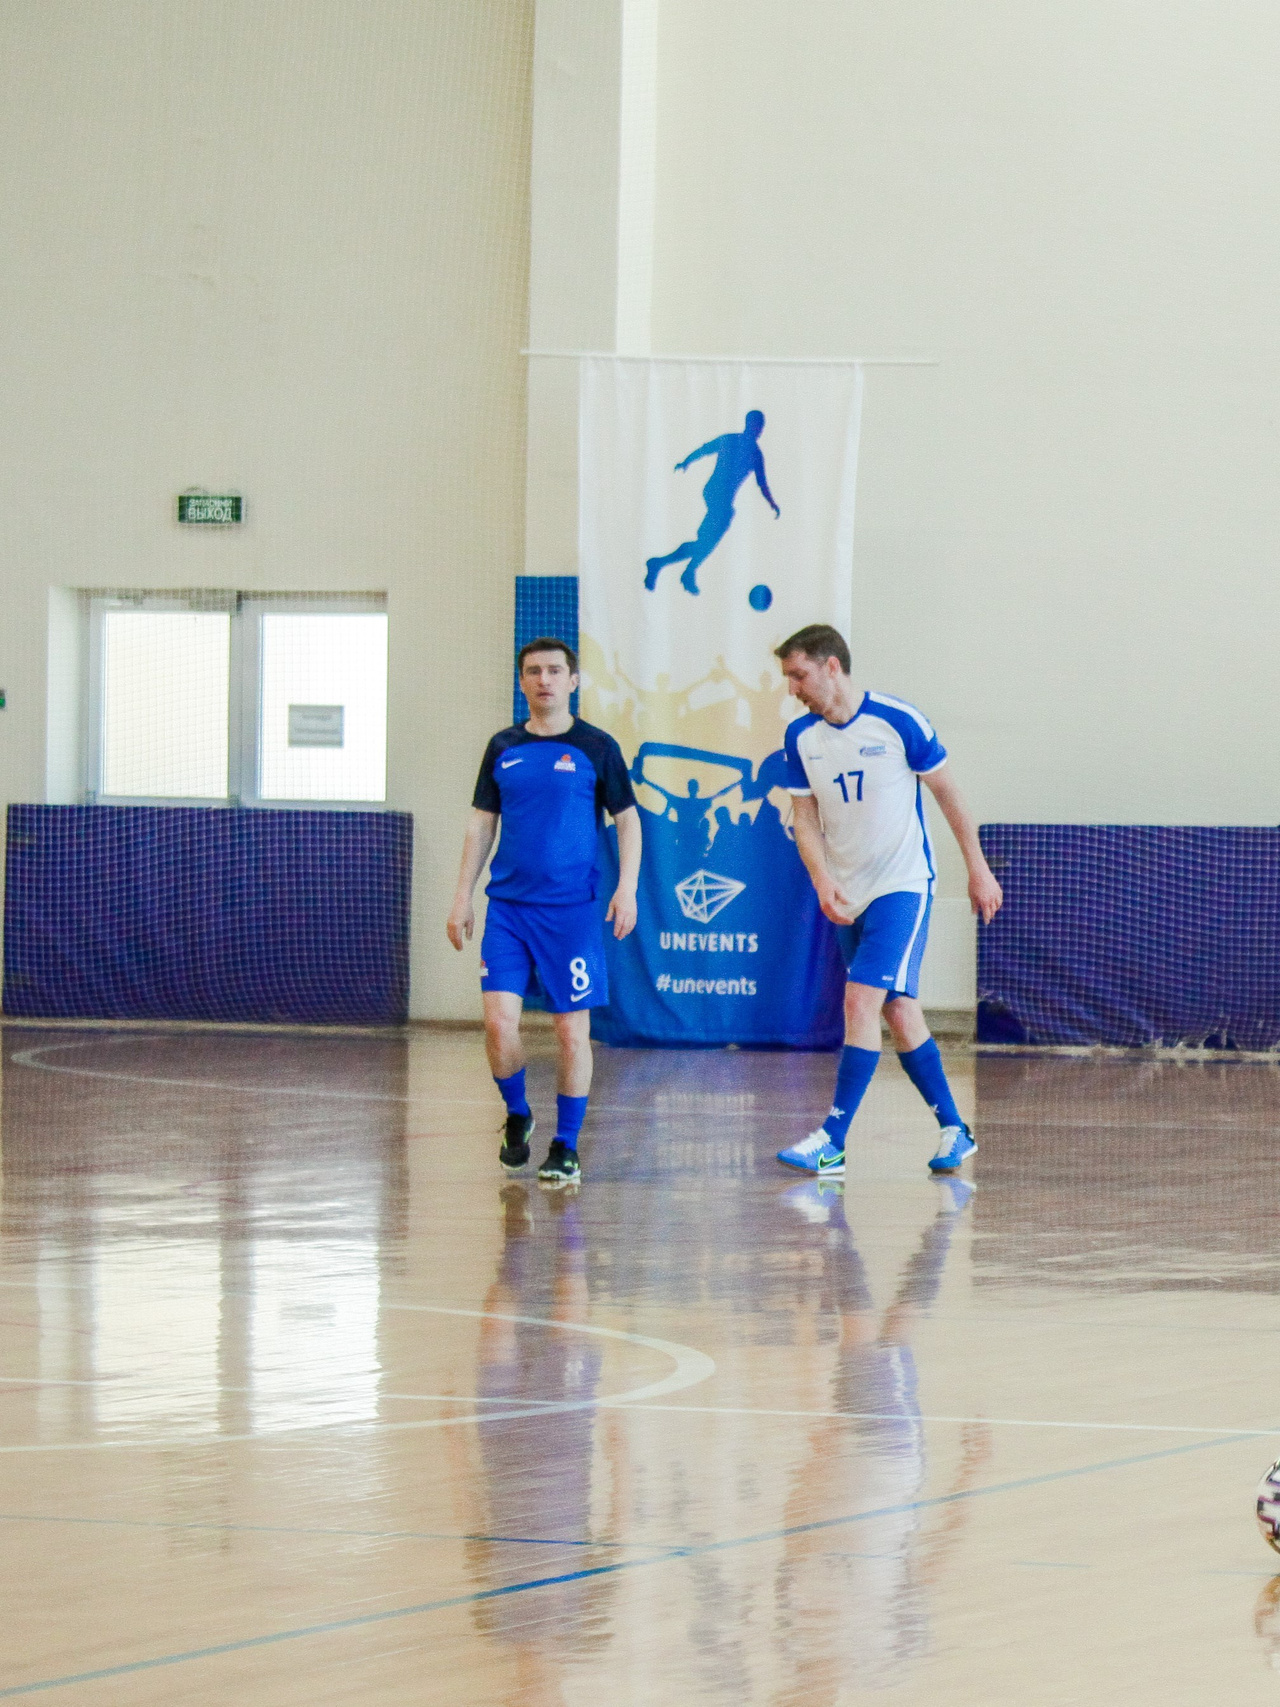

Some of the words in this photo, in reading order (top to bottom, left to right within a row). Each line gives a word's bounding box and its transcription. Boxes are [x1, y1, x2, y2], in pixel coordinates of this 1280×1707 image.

[188, 507, 233, 522] ВЫХОД
[832, 770, 864, 803] 17
[659, 931, 759, 953] UNEVENTS
[569, 956, 590, 991] 8
[655, 973, 758, 996] #unevents
